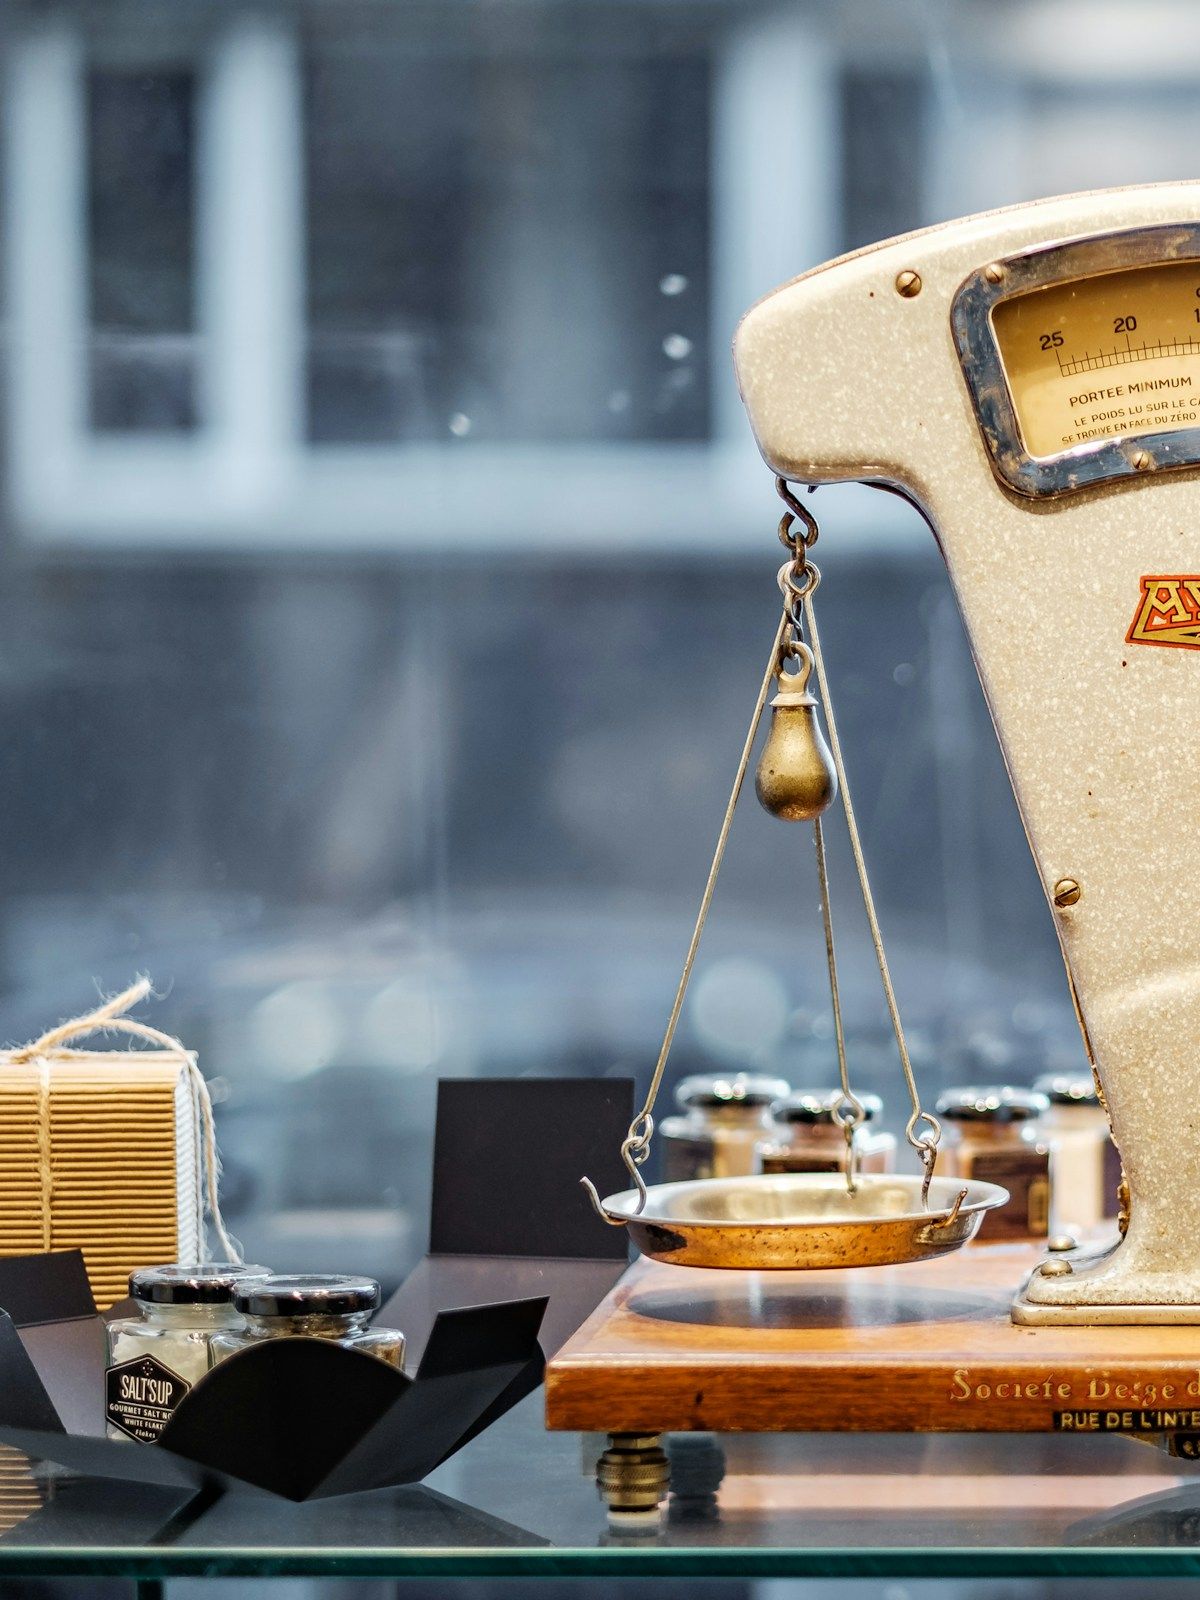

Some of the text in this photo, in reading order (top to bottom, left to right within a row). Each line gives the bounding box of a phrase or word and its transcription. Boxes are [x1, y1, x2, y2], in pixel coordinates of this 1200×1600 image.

[1039, 331, 1065, 350] 25
[1113, 316, 1137, 334] 20
[1069, 376, 1192, 407] PORTEE MINIMUM
[1073, 417, 1088, 427] LE
[1091, 409, 1125, 422] POIDS
[1128, 405, 1143, 415] LU
[1146, 402, 1169, 412] SUR
[1172, 399, 1186, 409] LE
[1061, 434, 1075, 444] SE
[1077, 425, 1113, 441] TROUVE
[1114, 423, 1127, 432] EN
[1129, 418, 1153, 428] FACE
[1154, 415, 1168, 425] DU
[109, 1403, 142, 1415] GOURMET
[143, 1408, 161, 1418] SALT
[124, 1418, 143, 1427] WHITE
[1060, 1411, 1100, 1429] RUE
[1106, 1411, 1133, 1428] DE
